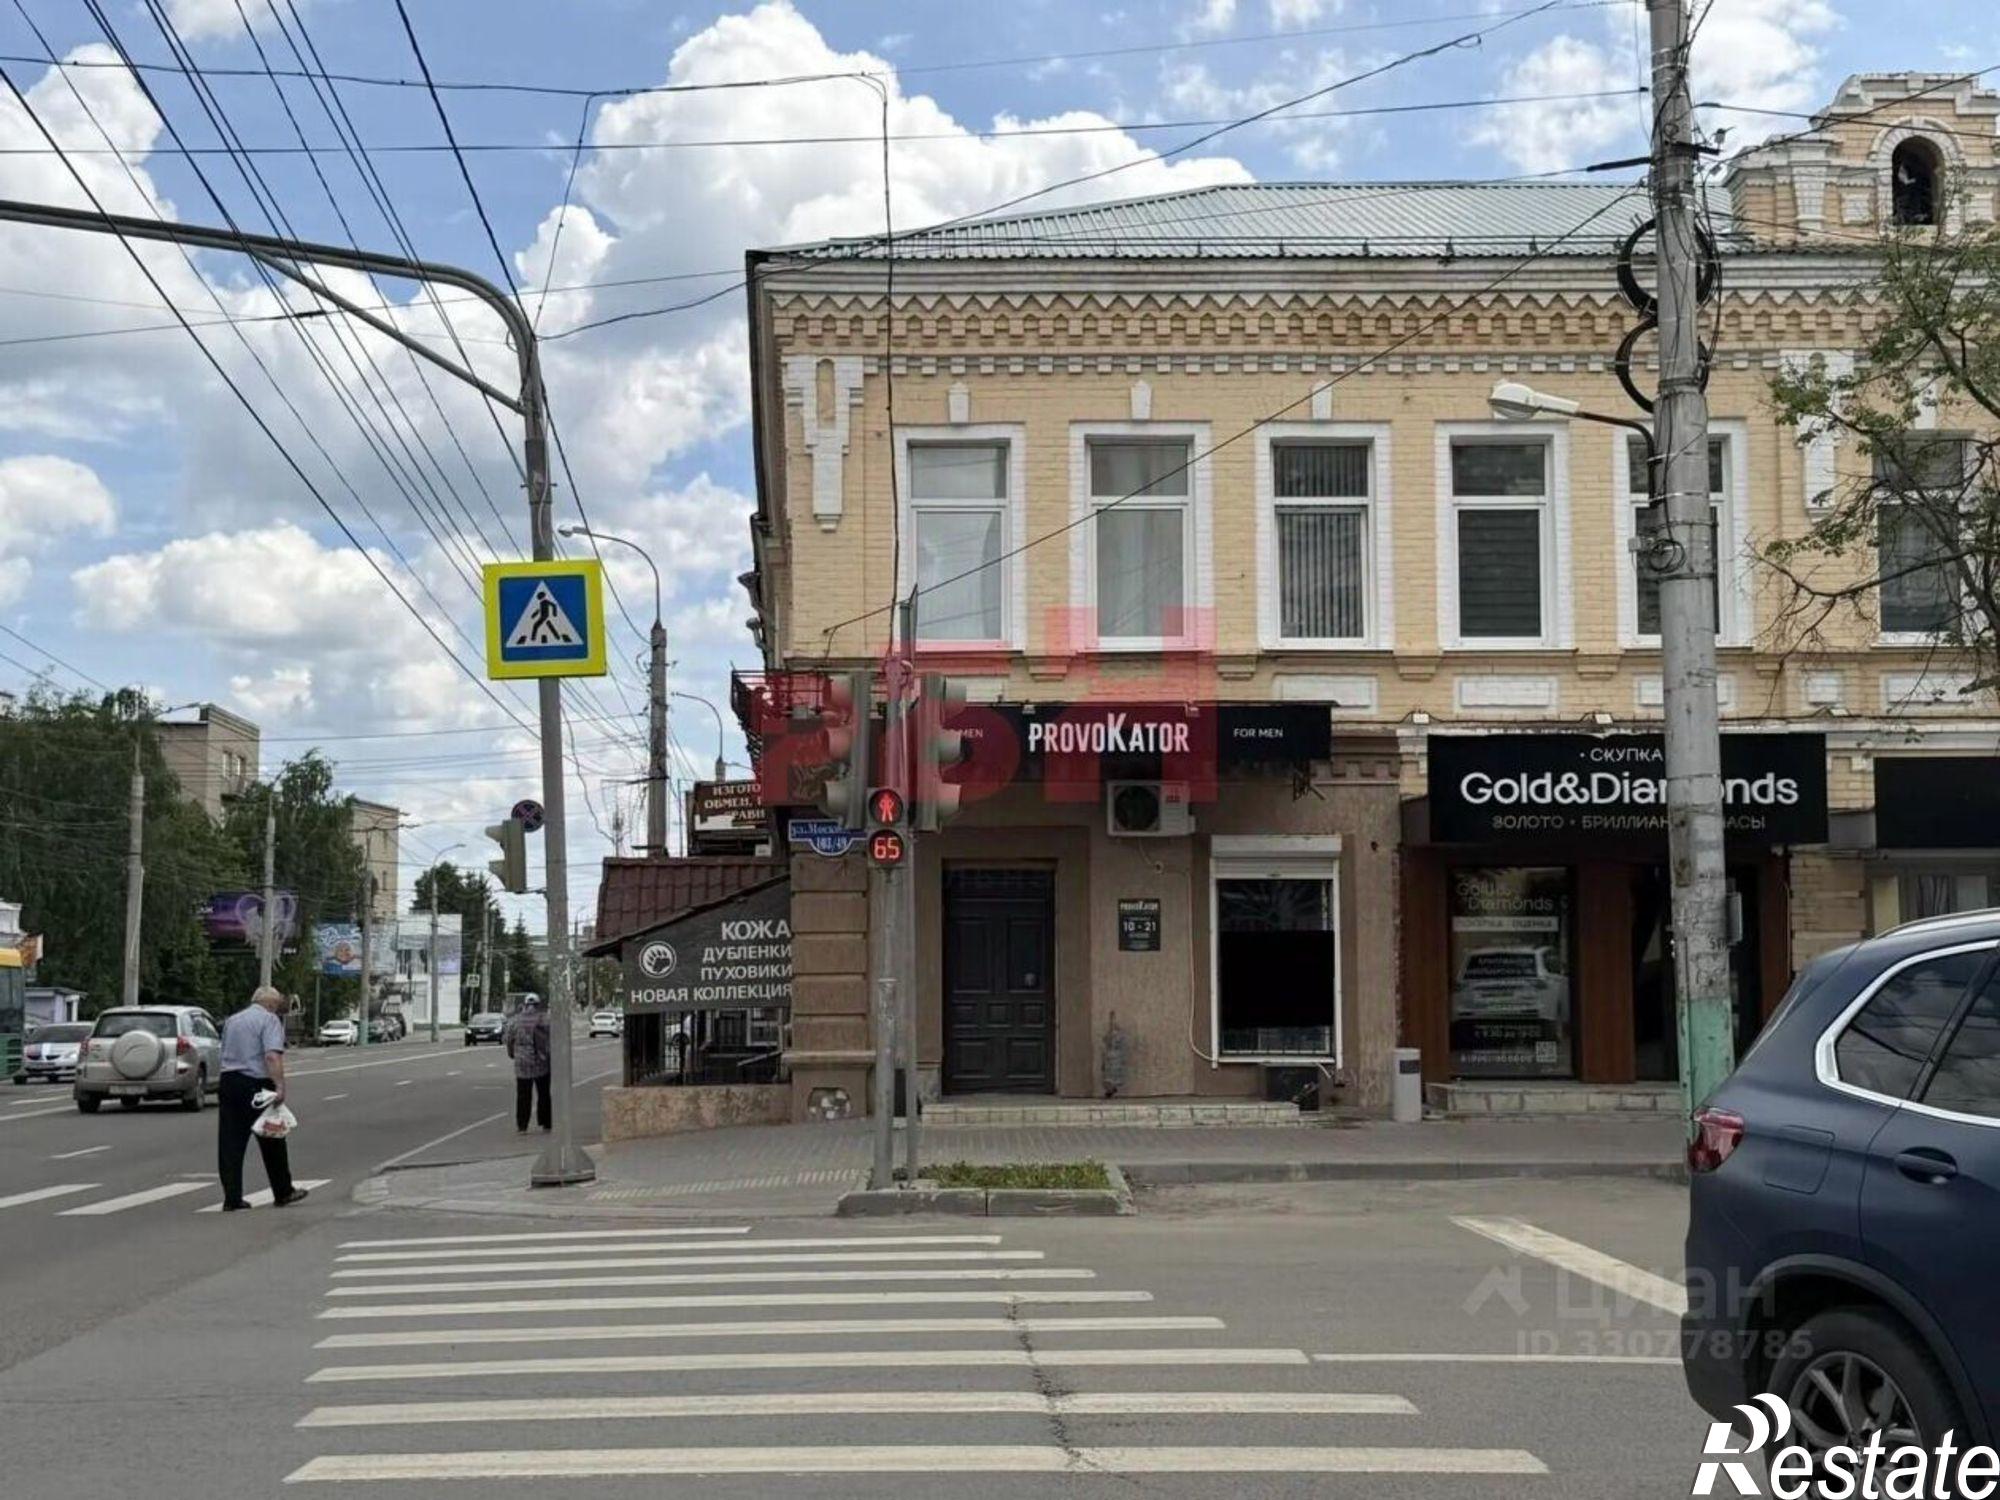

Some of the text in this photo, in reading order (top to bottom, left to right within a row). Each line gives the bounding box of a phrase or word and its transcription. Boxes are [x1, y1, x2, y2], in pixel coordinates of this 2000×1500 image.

[1028, 712, 1190, 752] PROVOKATOR
[1233, 727, 1283, 738] FOR MEN
[1590, 748, 1663, 763] СКУПКА
[712, 783, 762, 796] ИЗГОТО
[1460, 771, 1800, 805] Gold&Diands
[1492, 815, 1767, 830] ЗОЛОТО БРИЛЛИАН АСЫ
[874, 836, 900, 859] 65
[721, 918, 791, 941] КОЖА
[1123, 921, 1136, 932] 10
[1143, 921, 1157, 932] 21
[702, 944, 792, 963] ДУБЛЕНКИ
[701, 964, 792, 981] ПУХОВИКИ
[631, 983, 792, 1003] НОВАЯ КОЛЛЕКЦИЯ
